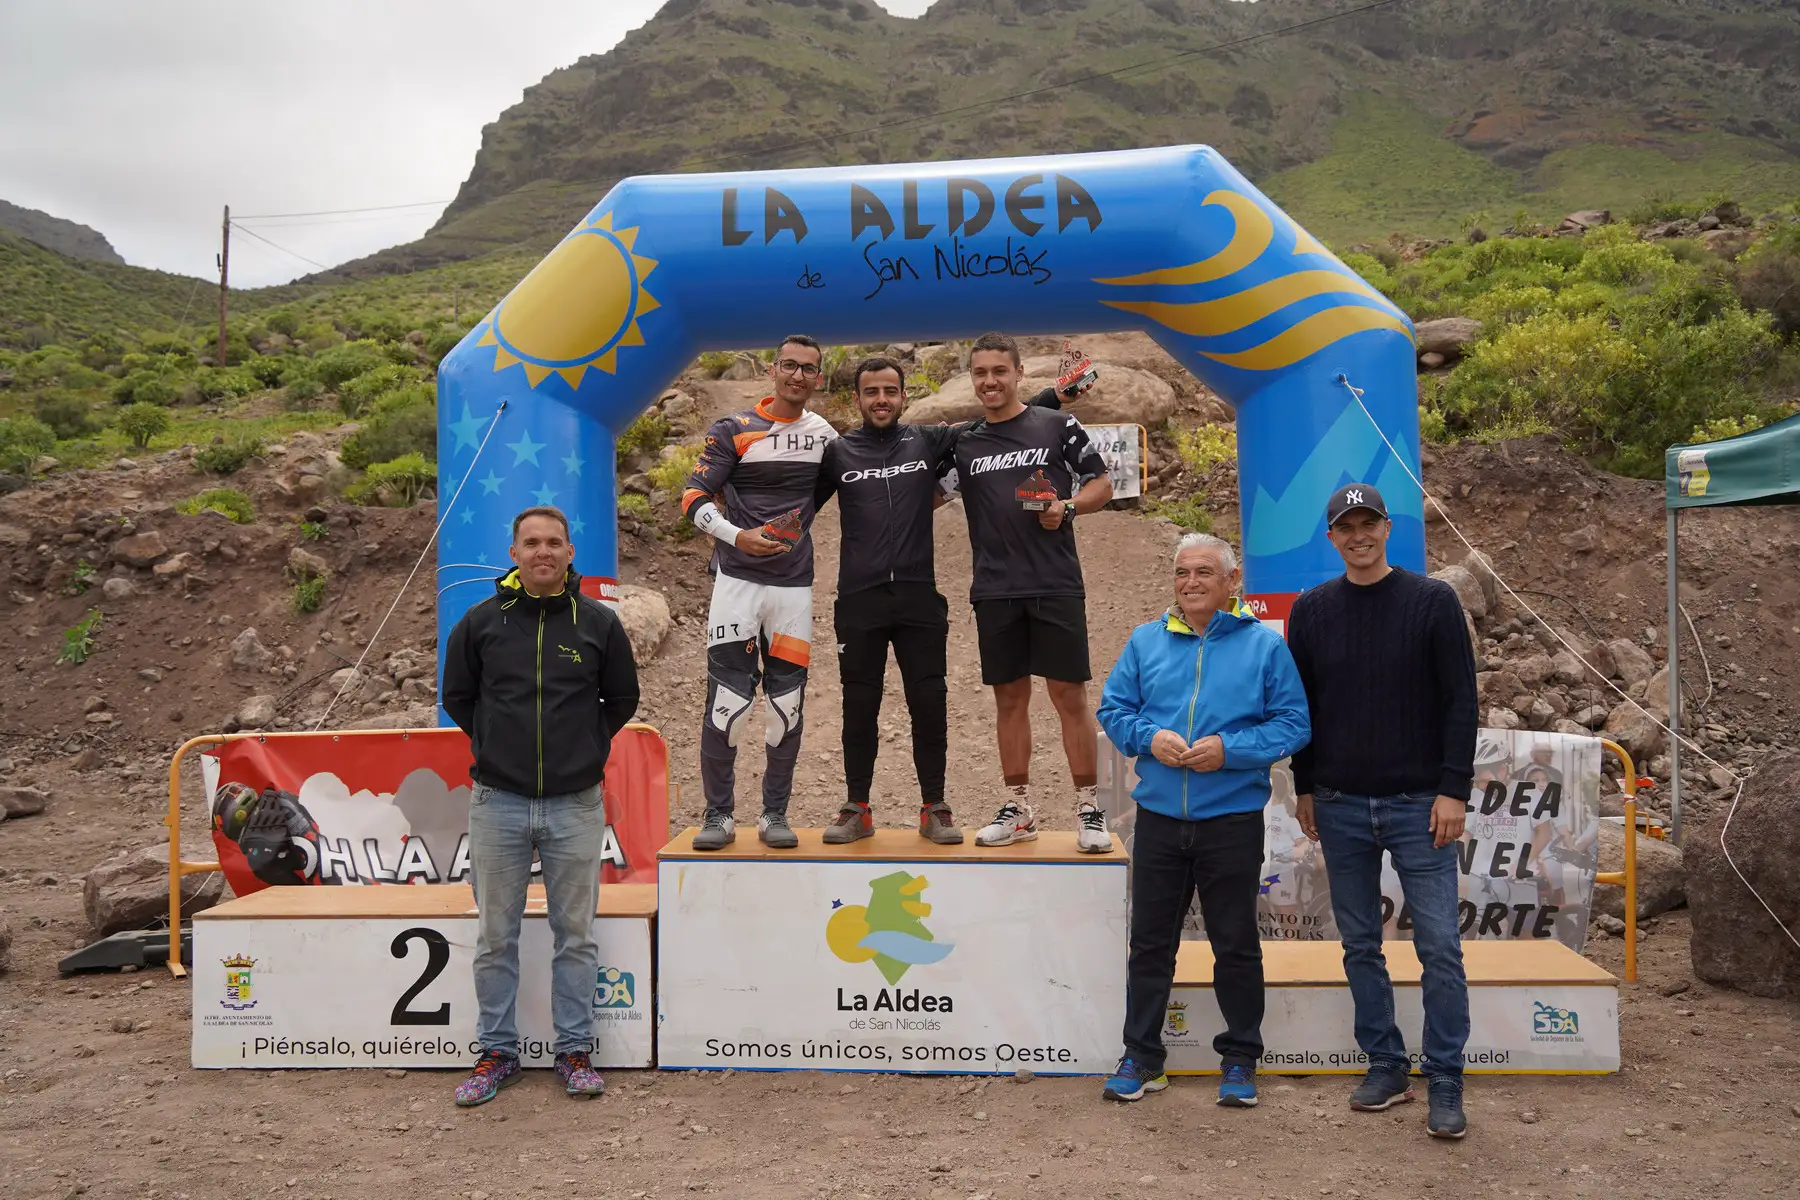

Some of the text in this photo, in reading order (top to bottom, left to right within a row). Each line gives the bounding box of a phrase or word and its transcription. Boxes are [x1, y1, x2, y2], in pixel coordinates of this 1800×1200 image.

[722, 173, 1103, 246] LA ALDEA
[796, 236, 1052, 301] de San Nicolás
[840, 460, 928, 483] ORBEA
[970, 447, 1050, 476] COMMENCAL
[363, 834, 441, 883] LA
[1489, 841, 1535, 879] EL
[1302, 915, 1322, 926] DE
[389, 927, 451, 1026] 2
[836, 987, 953, 1013] La Aldea
[849, 1017, 941, 1031] de San Nicolás
[254, 1037, 355, 1058] Piénsalo,
[362, 1036, 462, 1059] quiérelo,
[705, 1038, 1079, 1063] Somos únicos, somos Oeste.
